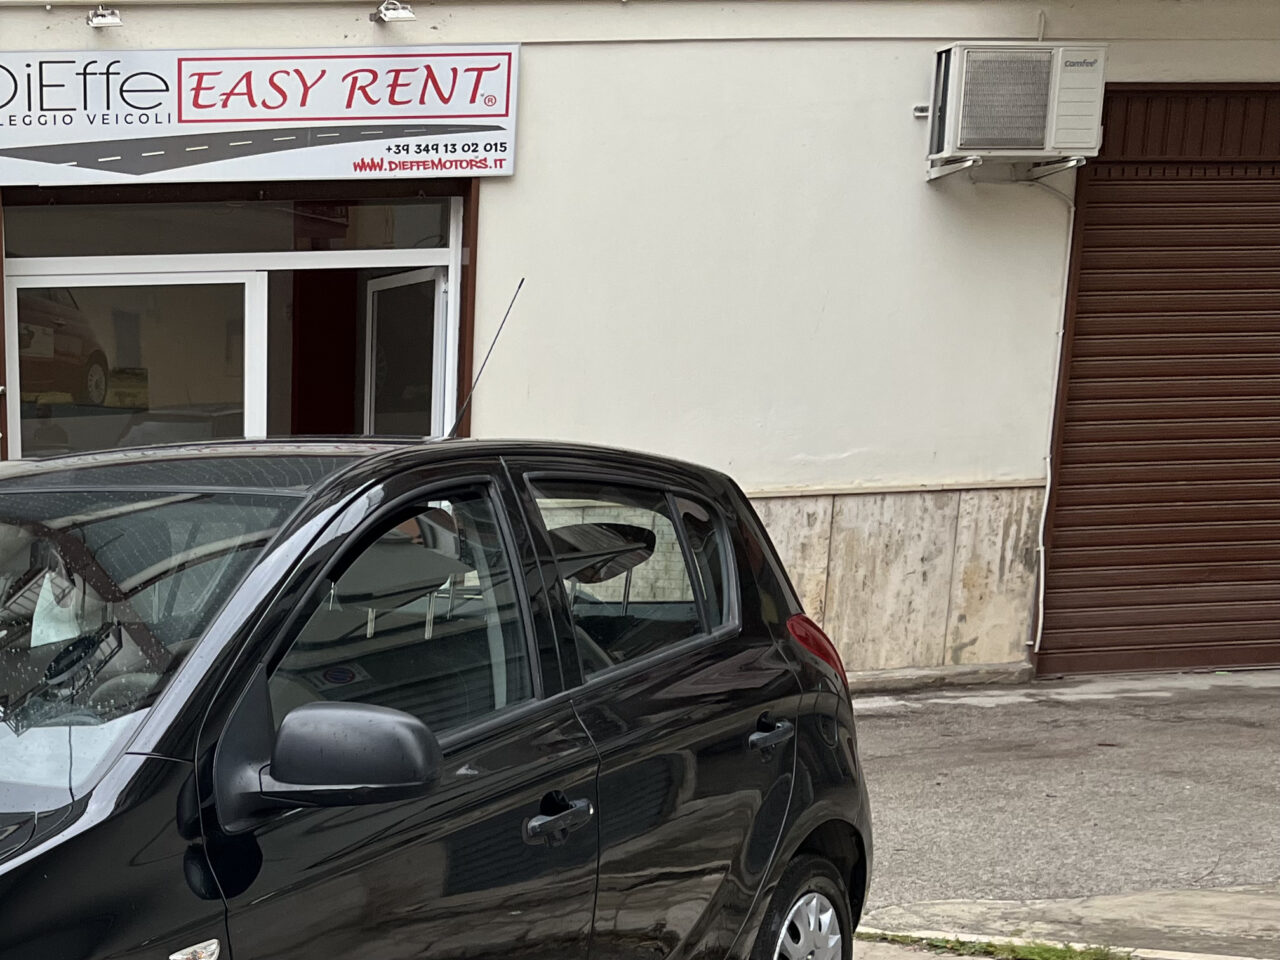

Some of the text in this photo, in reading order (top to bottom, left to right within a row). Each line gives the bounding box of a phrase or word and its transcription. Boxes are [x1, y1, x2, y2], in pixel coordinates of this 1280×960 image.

[188, 69, 326, 110] EASY
[87, 113, 171, 125] VEICOLI
[385, 142, 507, 155] +39 349 13 02 015
